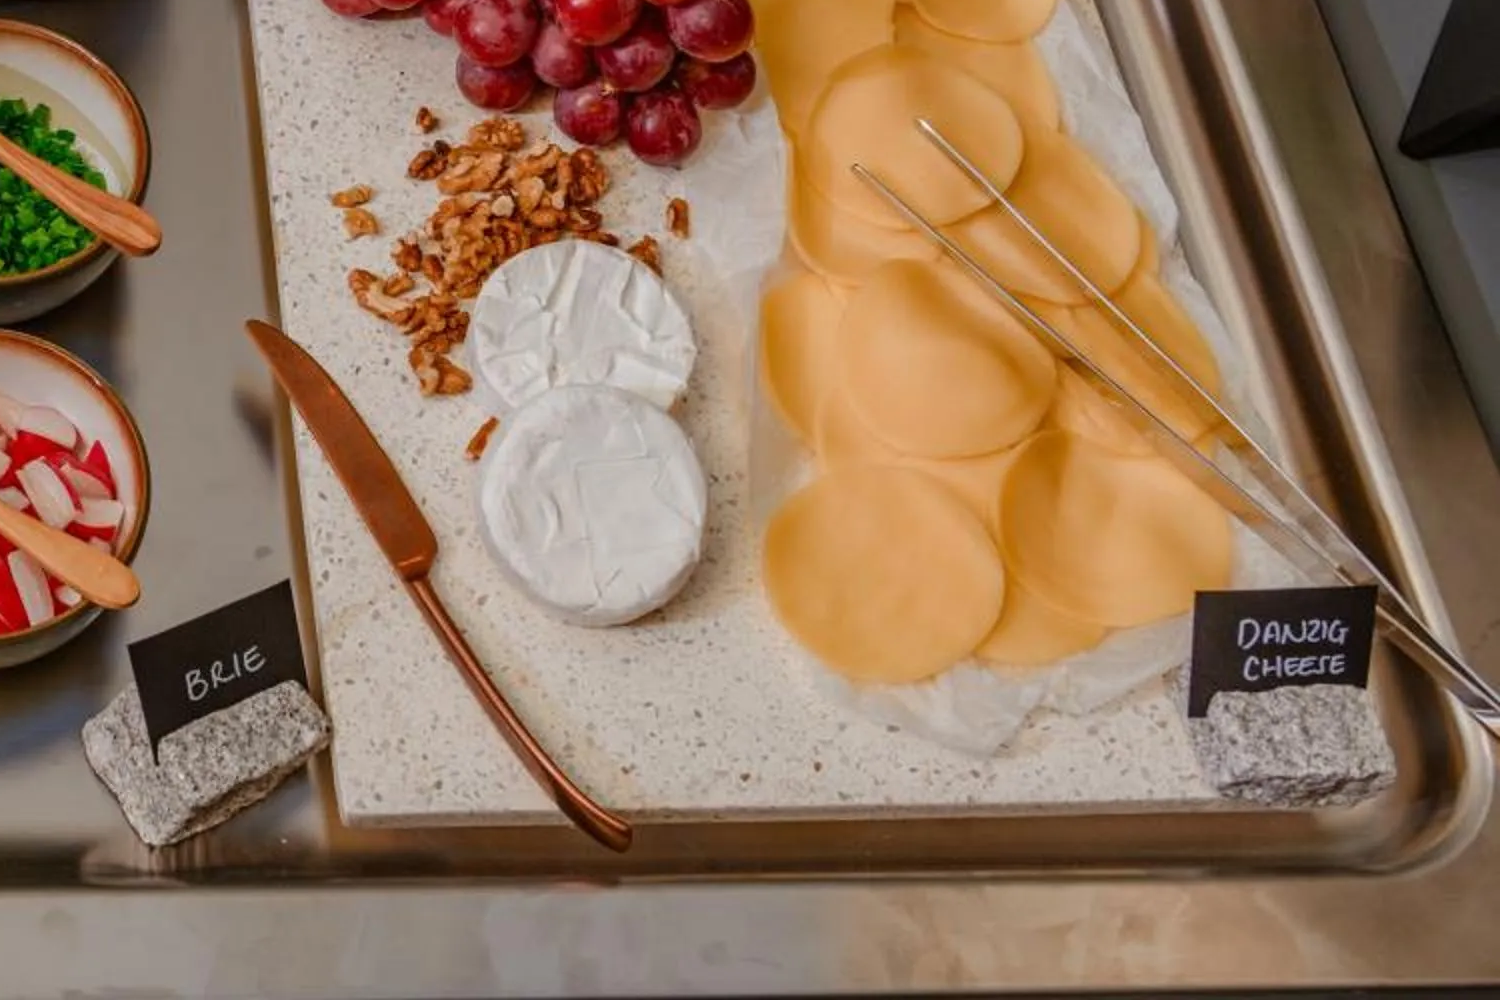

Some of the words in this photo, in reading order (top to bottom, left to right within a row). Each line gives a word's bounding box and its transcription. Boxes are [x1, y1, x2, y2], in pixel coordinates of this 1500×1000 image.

[1237, 618, 1349, 650] DANZIG
[185, 645, 267, 701] BRIE
[1243, 654, 1346, 681] CHEESE
